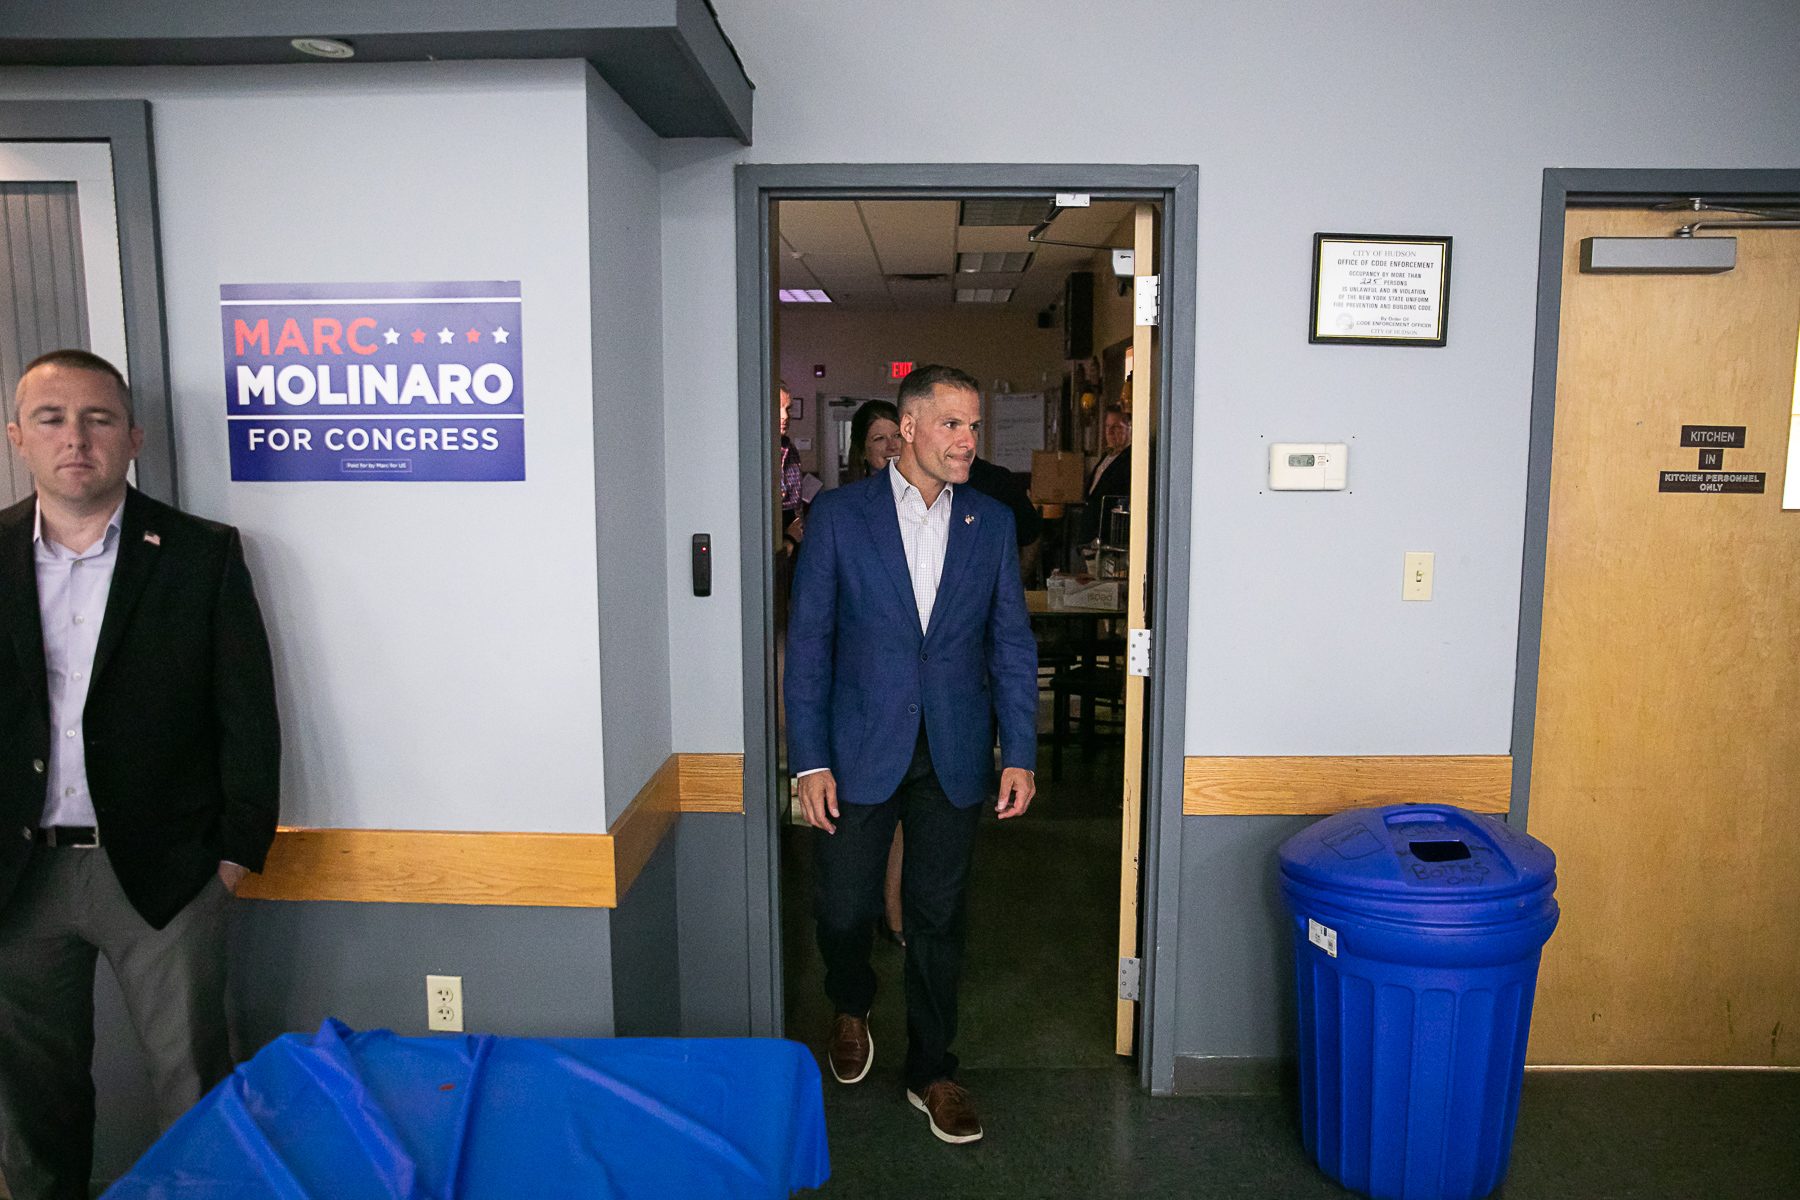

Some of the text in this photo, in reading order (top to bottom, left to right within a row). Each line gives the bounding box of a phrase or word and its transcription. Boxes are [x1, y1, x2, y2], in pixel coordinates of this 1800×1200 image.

[1390, 260, 1434, 268] ENFORCEMENT
[234, 317, 378, 356] MARC
[892, 362, 912, 378] EXIT
[236, 362, 514, 406] MOLINARO
[248, 427, 499, 451] FOR CONGRESS
[1690, 431, 1734, 442] KITCHEN
[1705, 454, 1716, 464] IN
[1664, 473, 1760, 482] KITCHEN PERSONNEL
[1700, 483, 1724, 492] ONLY
